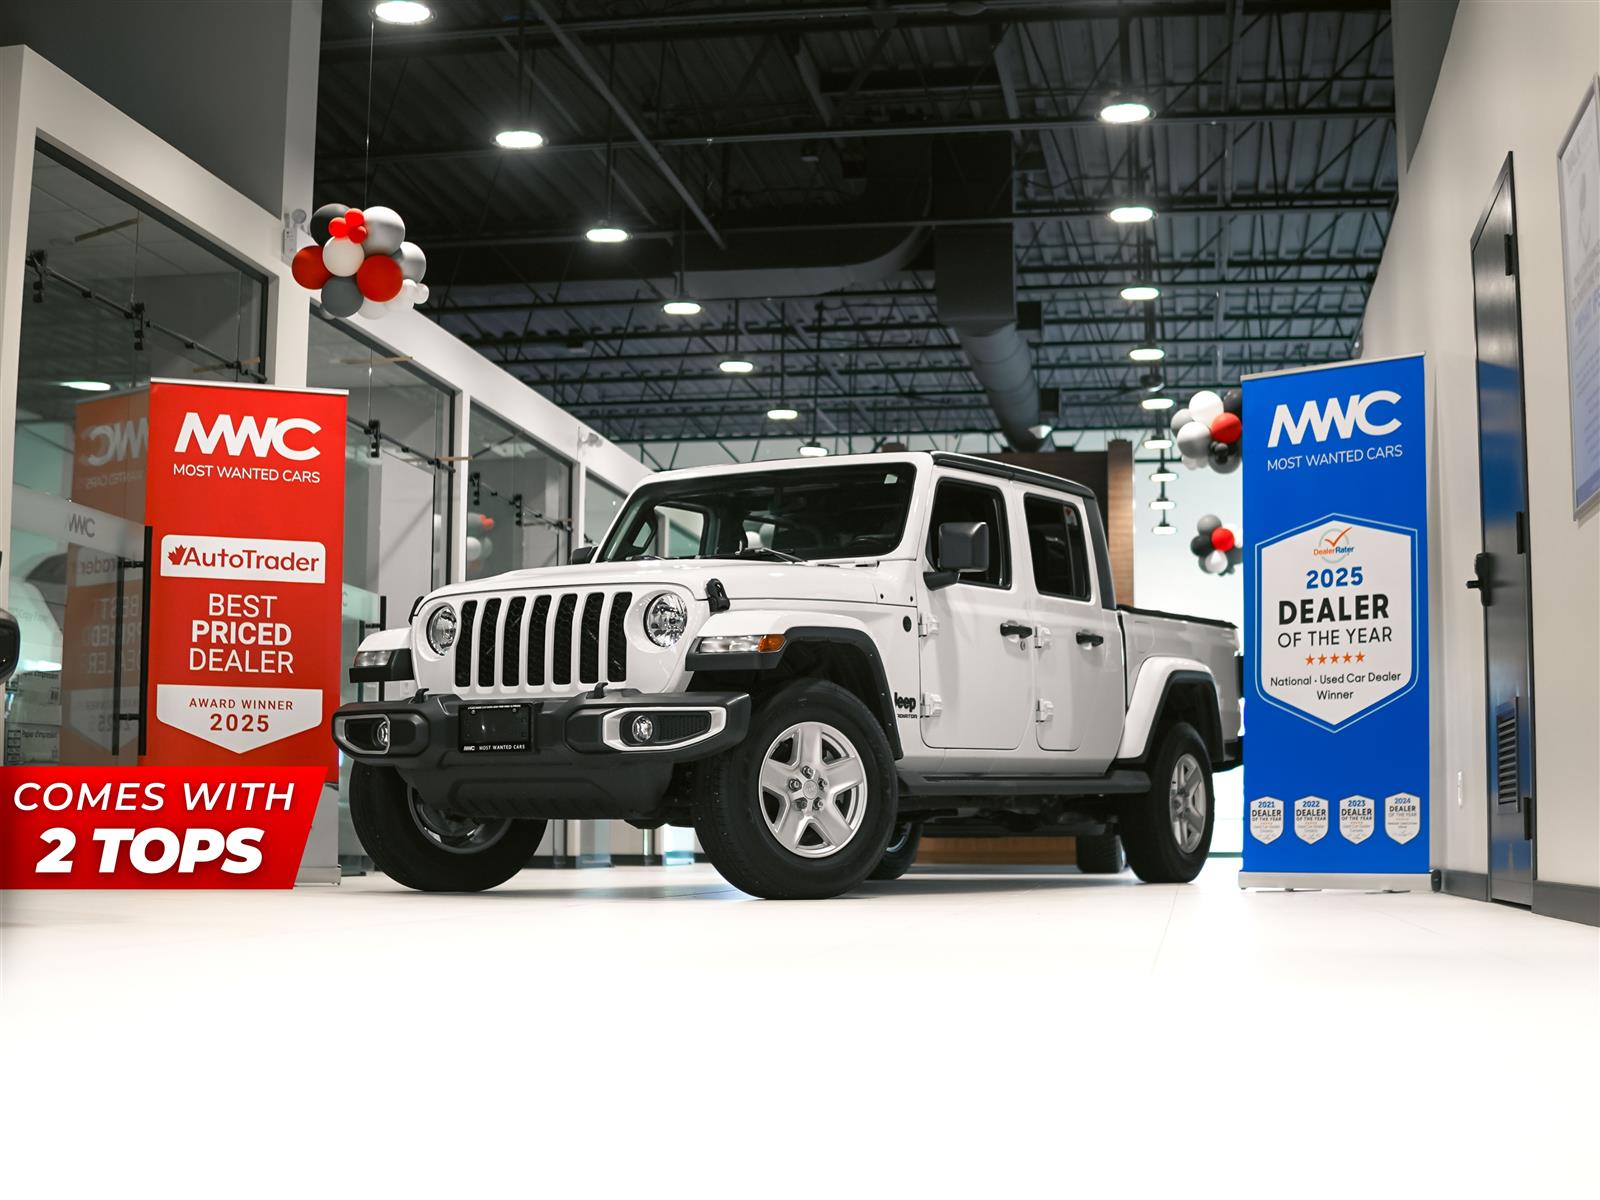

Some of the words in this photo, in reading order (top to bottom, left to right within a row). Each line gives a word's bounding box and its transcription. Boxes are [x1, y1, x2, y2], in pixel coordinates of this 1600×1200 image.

[1267, 390, 1402, 448] MWC
[174, 412, 322, 461] MWC
[1267, 456, 1302, 471] MOST
[1305, 449, 1364, 467] WANTED
[1366, 444, 1403, 461] CARS
[173, 463, 214, 477] MOST
[217, 466, 279, 482] WANTED
[282, 469, 321, 484] CARS
[183, 546, 320, 572] AutoTrader
[1306, 566, 1364, 589] 2025
[209, 593, 278, 619] BEST
[1279, 593, 1389, 625] DEALER
[192, 620, 292, 646] PRICED
[1278, 631, 1302, 648] OF
[1308, 629, 1340, 647] THE
[1346, 626, 1392, 645] YEAR
[190, 647, 294, 674] DEALER
[1270, 675, 1312, 687] National
[1320, 673, 1344, 685] Used
[1346, 672, 1366, 684] Car
[1368, 671, 1402, 682] Dealer
[189, 698, 236, 709] AWARD
[241, 699, 294, 711] WINNER
[1316, 689, 1354, 700] Winner
[210, 713, 270, 733] 2025
[1252, 809, 1282, 817] DEALER
[1303, 800, 1320, 808] 2022
[1341, 808, 1372, 816] DEALER
